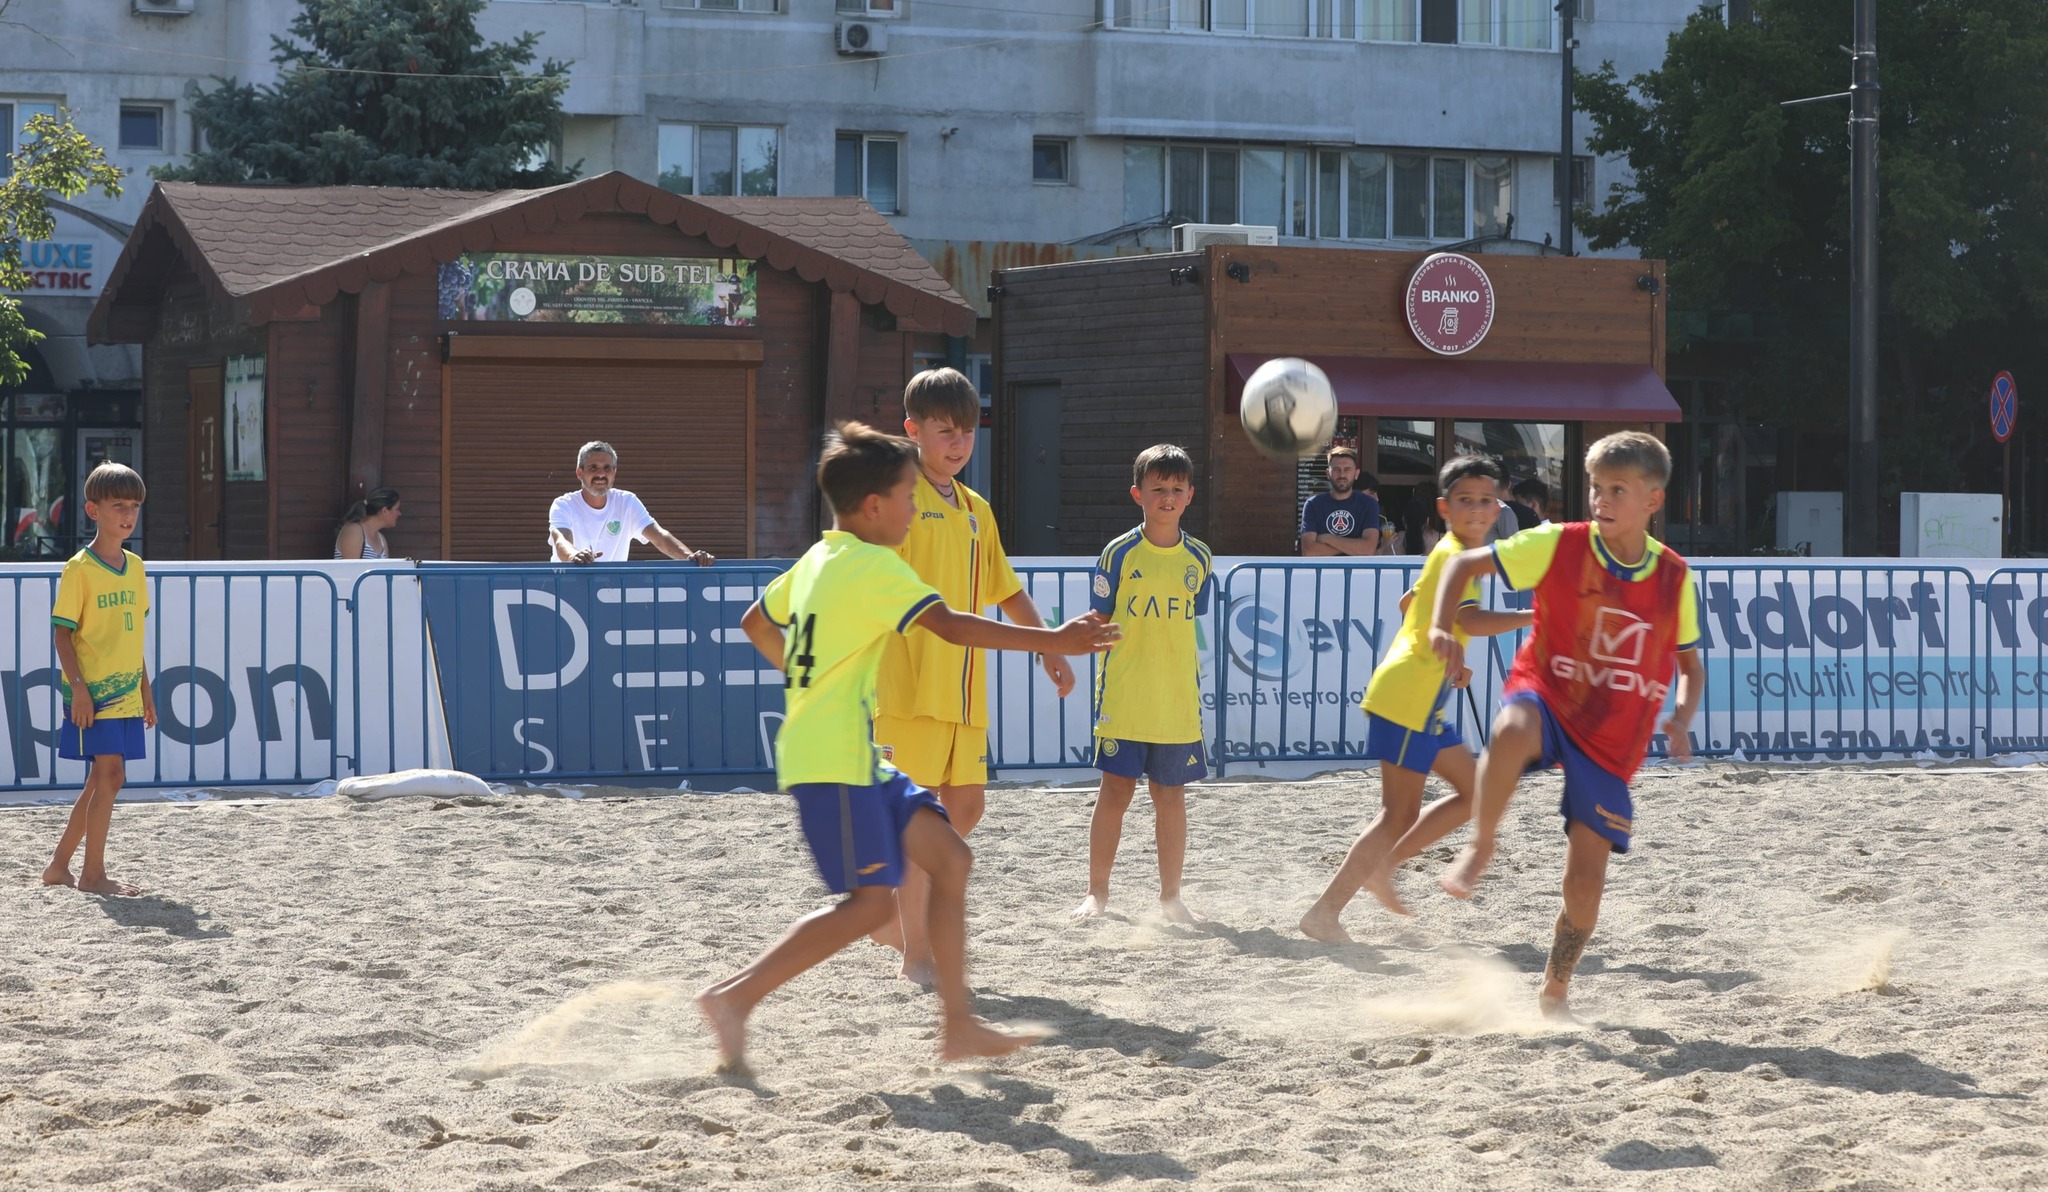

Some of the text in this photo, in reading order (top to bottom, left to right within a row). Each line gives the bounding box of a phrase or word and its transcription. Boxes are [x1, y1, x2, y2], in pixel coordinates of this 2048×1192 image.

[487, 260, 711, 284] CRAMA DE SUB TEI
[1435, 257, 1458, 265] CAFEA
[1415, 262, 1435, 286] DESPRE
[1467, 264, 1487, 287] DESPRE
[1421, 290, 1480, 303] BRANKO
[1412, 319, 1435, 346] POVESTE
[1331, 510, 1350, 518] PARIS
[1126, 595, 1196, 620] KAFD
[123, 612, 133, 632] 10
[1867, 669, 2001, 710] pentru
